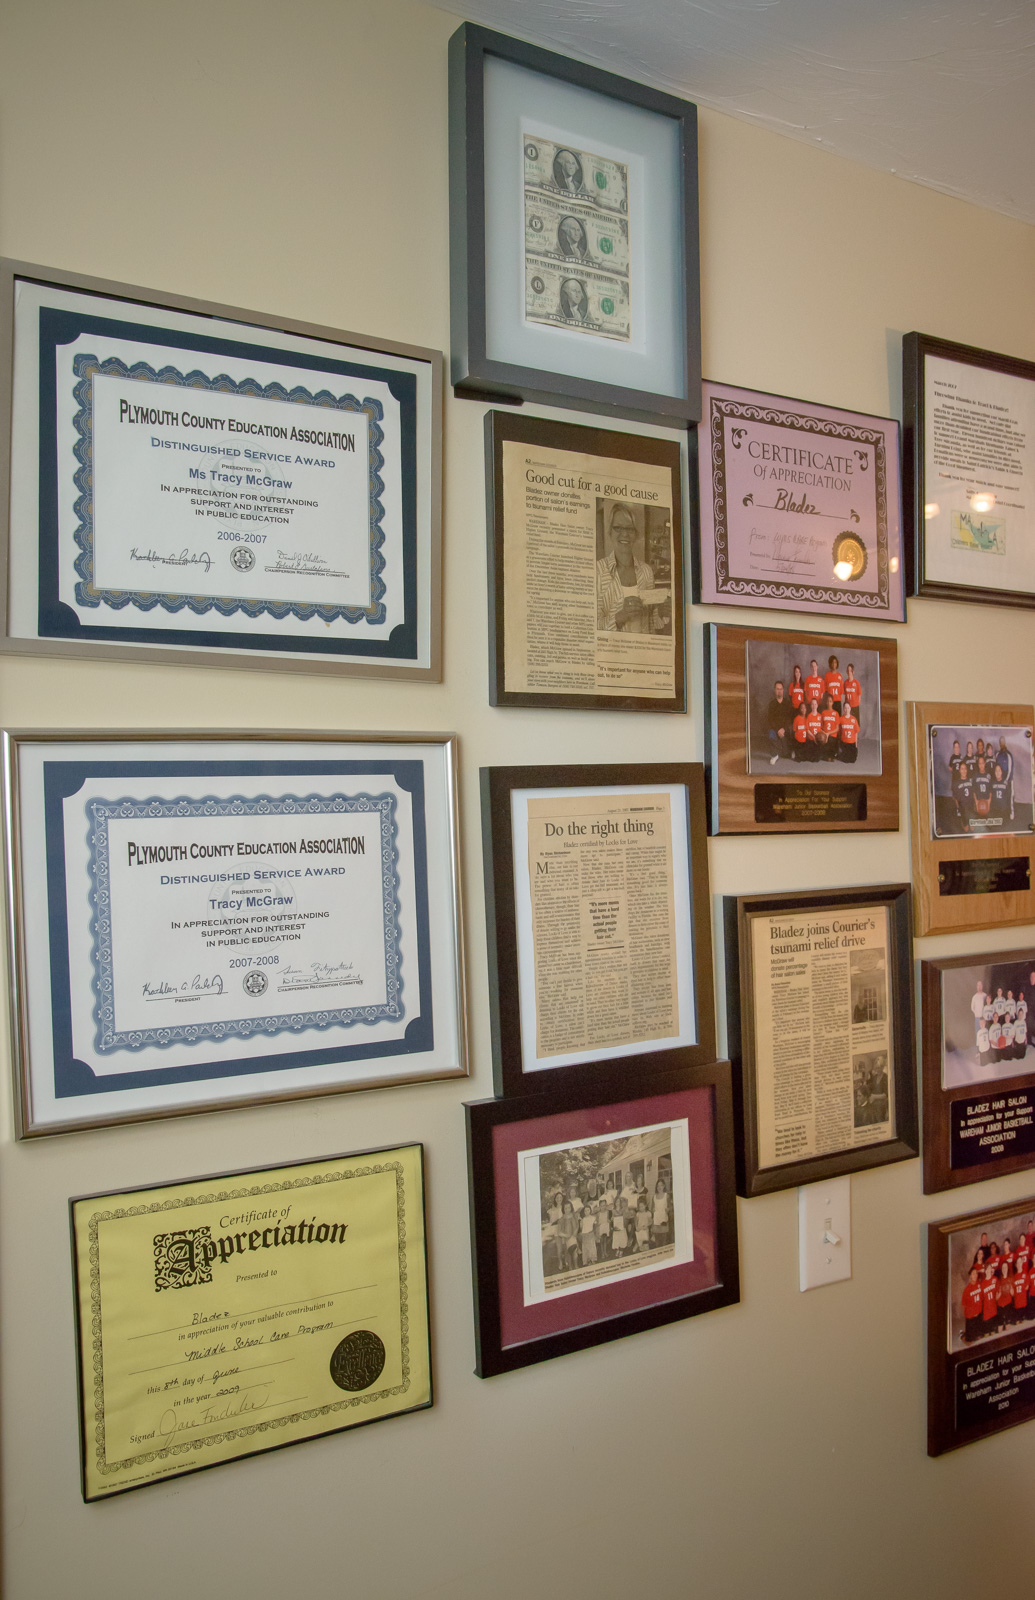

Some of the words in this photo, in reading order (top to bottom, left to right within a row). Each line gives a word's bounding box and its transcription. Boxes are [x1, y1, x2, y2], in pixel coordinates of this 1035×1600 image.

[119, 399, 179, 427] PLYMOUTH
[181, 411, 226, 431] COUNTY
[228, 418, 288, 439] EDUCATION
[290, 426, 355, 452] ASSOCIATION
[151, 437, 241, 457] DISTINGUISHED
[244, 449, 292, 463] SERVICE
[294, 455, 336, 468] AWARD
[748, 440, 854, 475] CERTIFICATE
[188, 467, 207, 480] Ms
[210, 470, 242, 486] Tracy
[246, 474, 293, 489] McGraw
[221, 463, 253, 472] PRESENTED
[753, 463, 768, 480] Of
[769, 467, 852, 492] APPRECIATION
[525, 469, 555, 486] Good
[558, 476, 575, 489] cut
[577, 476, 592, 491] for
[594, 483, 602, 492] a
[604, 484, 628, 497] good
[630, 487, 659, 501] cause
[160, 484, 171, 492] IN
[172, 486, 238, 500] APPRECIATION
[240, 493, 258, 501] FOR
[259, 495, 319, 508] OUTSTANDING
[190, 498, 231, 509] SUPPORT
[233, 502, 252, 511] AND
[253, 505, 295, 515] INTEREST
[773, 488, 821, 515] Bladez
[206, 510, 239, 520] PUBLIC
[240, 513, 290, 524] EDUCATION
[217, 530, 268, 545] 2006-2007
[545, 822, 564, 837] Do
[568, 821, 587, 836] the
[590, 820, 620, 839] right
[623, 819, 655, 836] thing
[127, 841, 188, 866] PLYMOUTH
[190, 842, 235, 859] COUNTY
[237, 841, 297, 856] EDUCATION
[299, 835, 365, 855] ASSOCIATION
[160, 872, 251, 885] DISTINGUISHED
[253, 869, 302, 880] SERVICE
[304, 867, 346, 877] AWARD
[209, 899, 243, 911] Tracy
[246, 895, 293, 908] McGraw
[171, 921, 181, 929] IN
[183, 917, 249, 929] APPRECIATION
[270, 912, 330, 922] OUTSTANDING
[201, 927, 242, 938] SUPPORT
[244, 926, 263, 934] AND
[265, 923, 306, 932] INTEREST
[770, 925, 805, 940] Bladez
[806, 923, 830, 938] joins
[832, 917, 876, 934] Courier's
[206, 940, 216, 948] IN
[217, 937, 250, 947] PUBLIC
[251, 933, 301, 944] EDUCATION
[770, 939, 811, 955] tsunami
[814, 936, 840, 950] relief
[841, 934, 866, 948] drive
[229, 955, 280, 969] 2007-2008
[966, 1102, 990, 1116] BLADEZ
[992, 1099, 1006, 1110] HAIR
[1007, 1095, 1028, 1107] SALON
[959, 1126, 984, 1139] WAREHAM
[986, 1122, 1002, 1133] JUNIOR
[1003, 1116, 1034, 1129] BASKETBALL
[979, 1131, 1016, 1146] ASSOCIATION
[219, 1207, 278, 1229] Certificate
[280, 1205, 292, 1219] of
[160, 1216, 349, 1278] Appreciation
[235, 1270, 269, 1283] Presented
[270, 1268, 278, 1276] to
[178, 1333, 186, 1341] in
[187, 1324, 230, 1340] appreciation
[230, 1320, 240, 1330] of
[239, 1318, 256, 1329] your
[257, 1310, 284, 1324] valuable
[285, 1303, 326, 1318] contribution
[191, 1311, 231, 1326] Bladez
[184, 1342, 226, 1362] Middle
[232, 1336, 264, 1351] School
[297, 1321, 334, 1335] Program
[966, 1359, 994, 1377] BLADEZ
[997, 1352, 1014, 1367] HAIR
[1016, 1345, 1035, 1360] SALO
[146, 1386, 161, 1395] this
[182, 1376, 196, 1387] day
[196, 1374, 205, 1385] of
[965, 1386, 992, 1400] Wareham
[994, 1379, 1011, 1391] Junior
[173, 1399, 182, 1407] in
[183, 1395, 195, 1405] the
[196, 1393, 211, 1404] year
[215, 1385, 240, 1397] 2009
[988, 1387, 1020, 1404] Association
[129, 1430, 155, 1444] Signed
